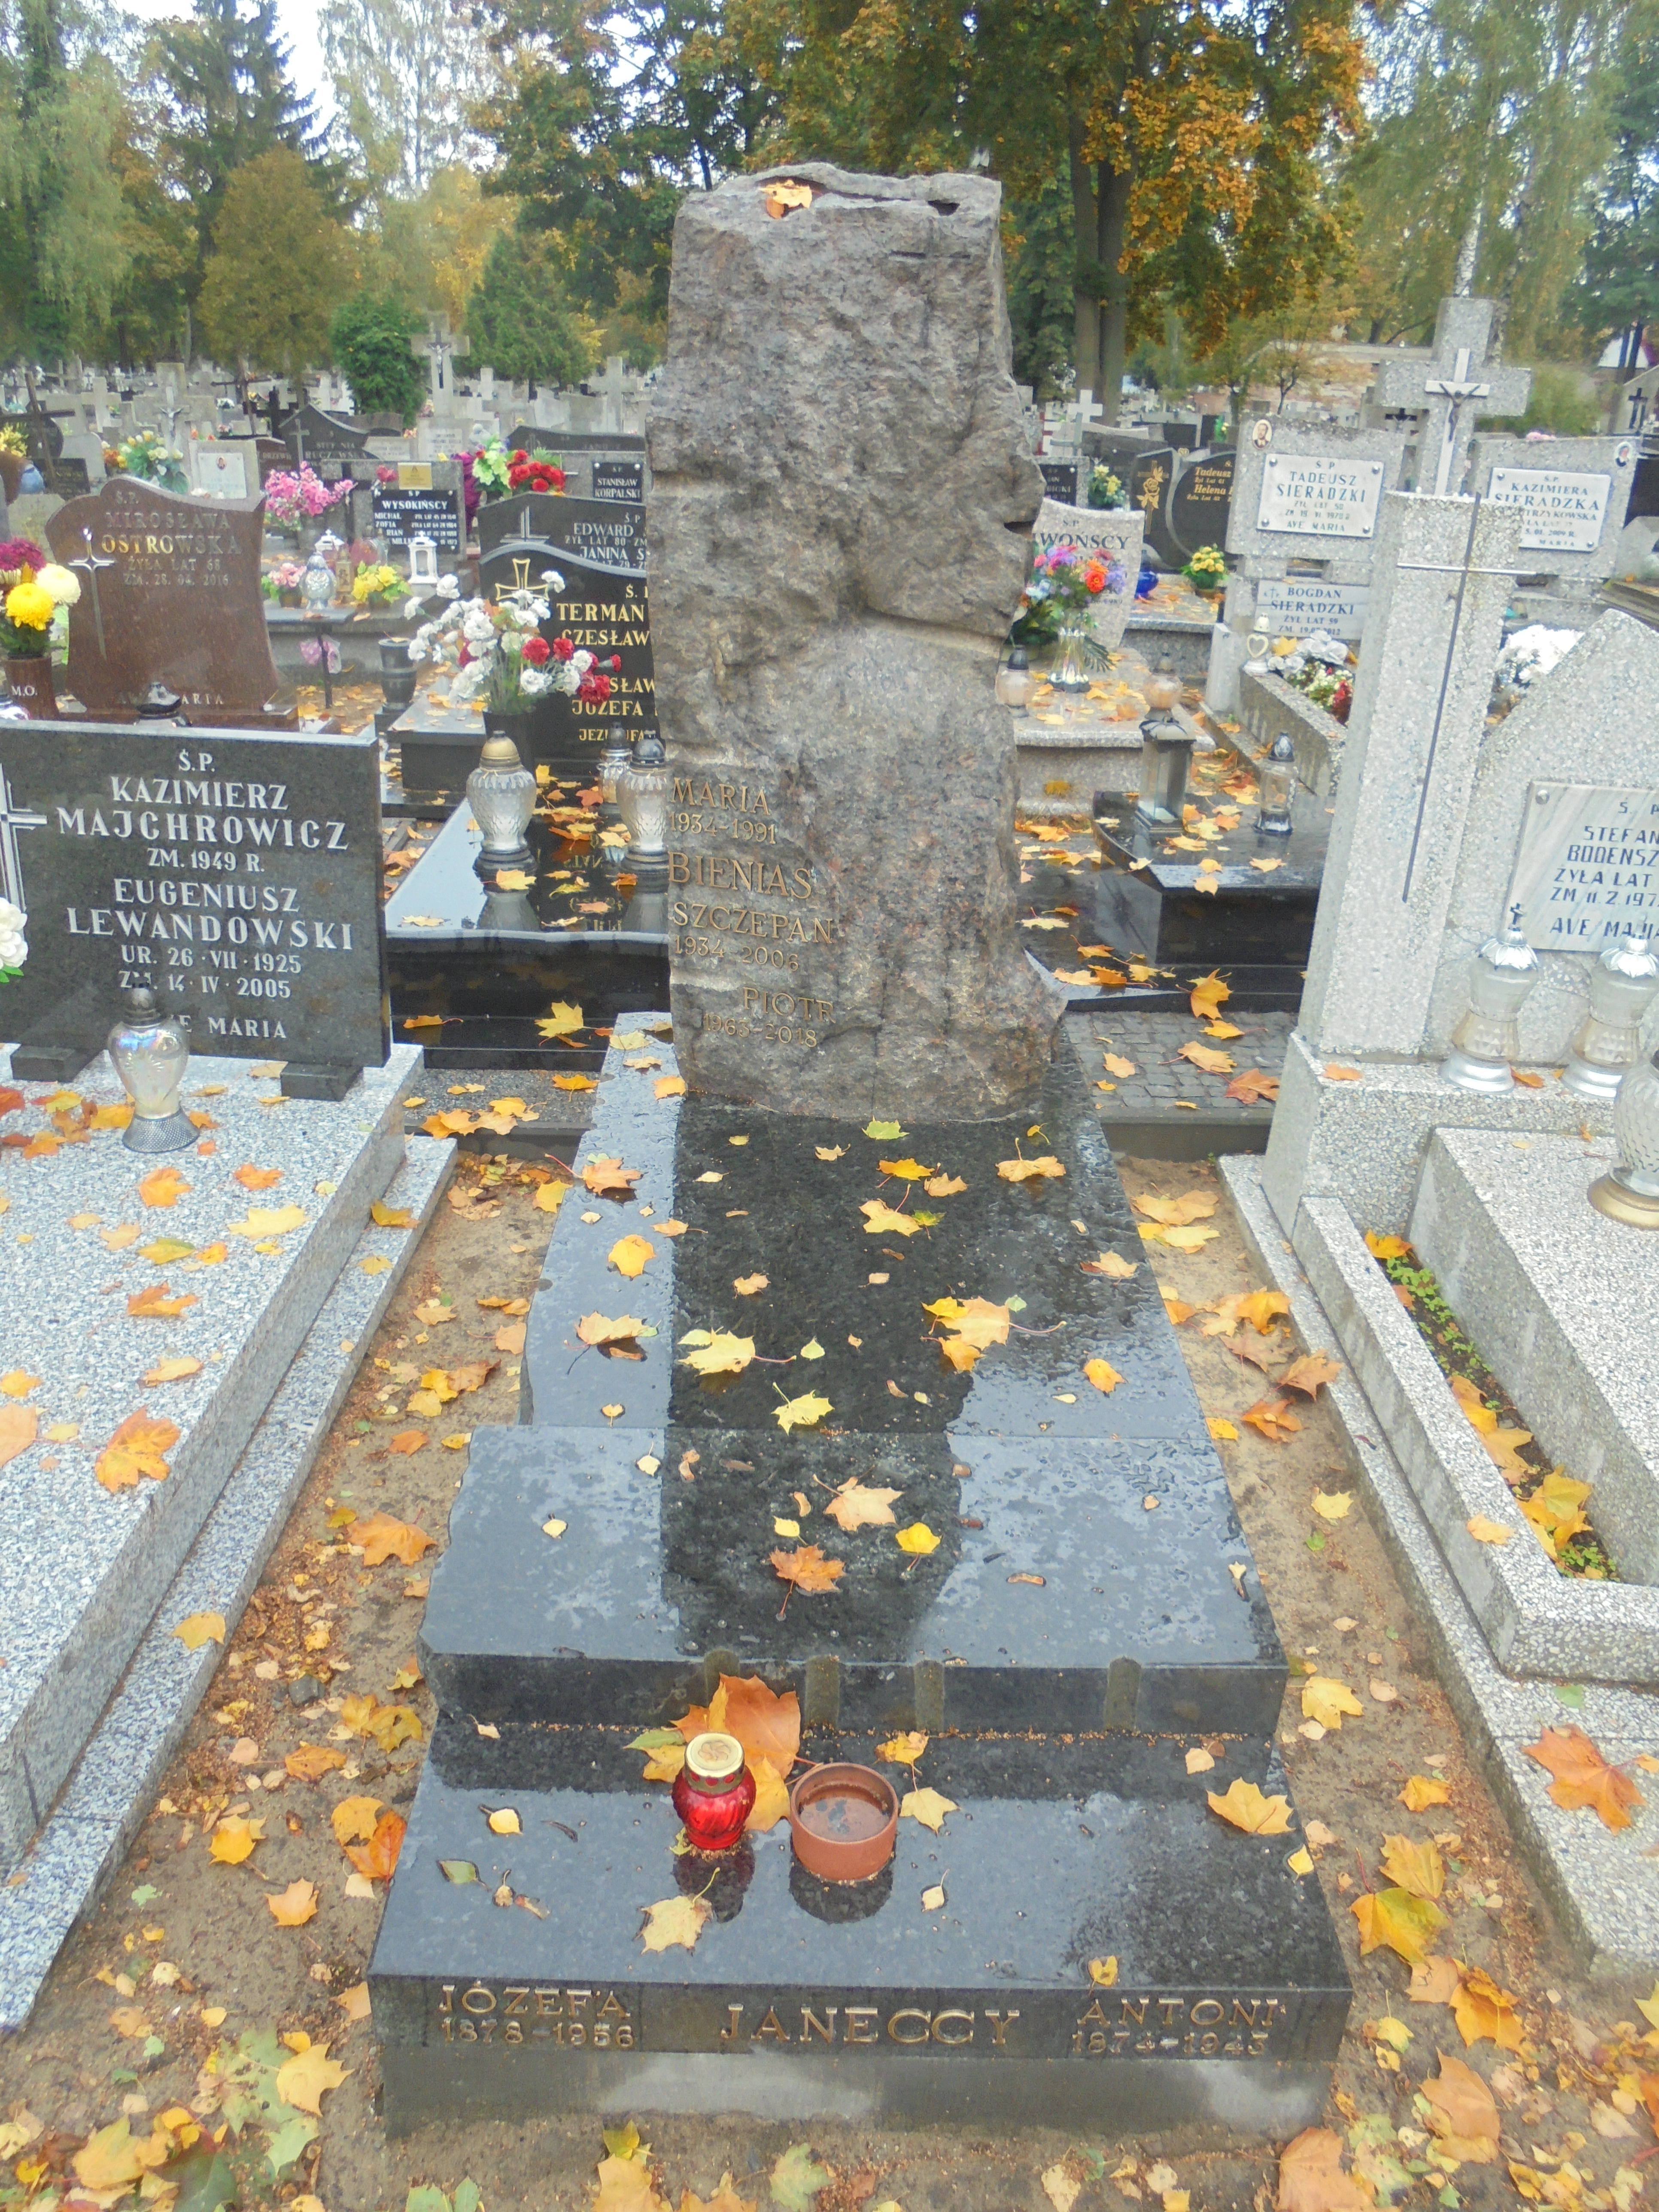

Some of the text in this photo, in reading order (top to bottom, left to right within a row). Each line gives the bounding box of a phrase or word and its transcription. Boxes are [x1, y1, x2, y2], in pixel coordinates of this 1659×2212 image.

[1195, 467, 1231, 477] Tadeusz
[1290, 471, 1357, 486] TADEUSZ
[597, 478, 638, 486] STANISŁAW
[1194, 484, 1226, 495] Helena
[1511, 482, 1589, 495] KAZIMIERA
[595, 488, 641, 498] KORPALSKI
[1277, 483, 1366, 502] SIERADZKI
[382, 499, 447, 510] WYSOKIŃSCY
[1495, 494, 1599, 510] SIERADZKA
[106, 512, 231, 529] MIROSŁAWA
[574, 522, 634, 537] EDWARD
[1287, 520, 1345, 532] AVE MARIA
[101, 534, 242, 554] OSTROWSKA
[580, 546, 628, 560] JANINA
[128, 556, 162, 571] ŻYŁA
[171, 559, 196, 571] LAT
[203, 574, 229, 586] 2016
[1288, 587, 1342, 599] BOGDAN
[556, 603, 644, 622] TERMAN
[1271, 600, 1355, 615] SIERADZKI
[11, 685, 38, 697] M.O.
[181, 693, 224, 705] ARIA
[179, 748, 215, 772] Ś.P.
[110, 776, 289, 811] KAZIMIERZ
[669, 777, 771, 815] MARIA
[56, 807, 349, 850] MAJCHROWICZ
[147, 848, 265, 873] ZM. 1949 R.
[668, 852, 811, 899] BIENIAS
[1613, 872, 1653, 888] LAT
[113, 878, 301, 912] EUGENIUSZ
[1550, 886, 1577, 902] ZM
[66, 907, 353, 951] LEWANDOWSKI
[672, 902, 833, 944] SZCZEPAN
[1549, 917, 1591, 936] AVE
[121, 945, 301, 973] UR. 26 VII 1925
[167, 973, 185, 992] 14
[201, 976, 219, 994] IV
[237, 977, 291, 998] 2005
[743, 987, 836, 1024] PIOTR
[208, 1017, 286, 1039] MARIA
[439, 1980, 631, 2018] JÓZEFA
[1076, 1997, 1278, 2027] ANTONI
[720, 2002, 1021, 2045] JANECCY
